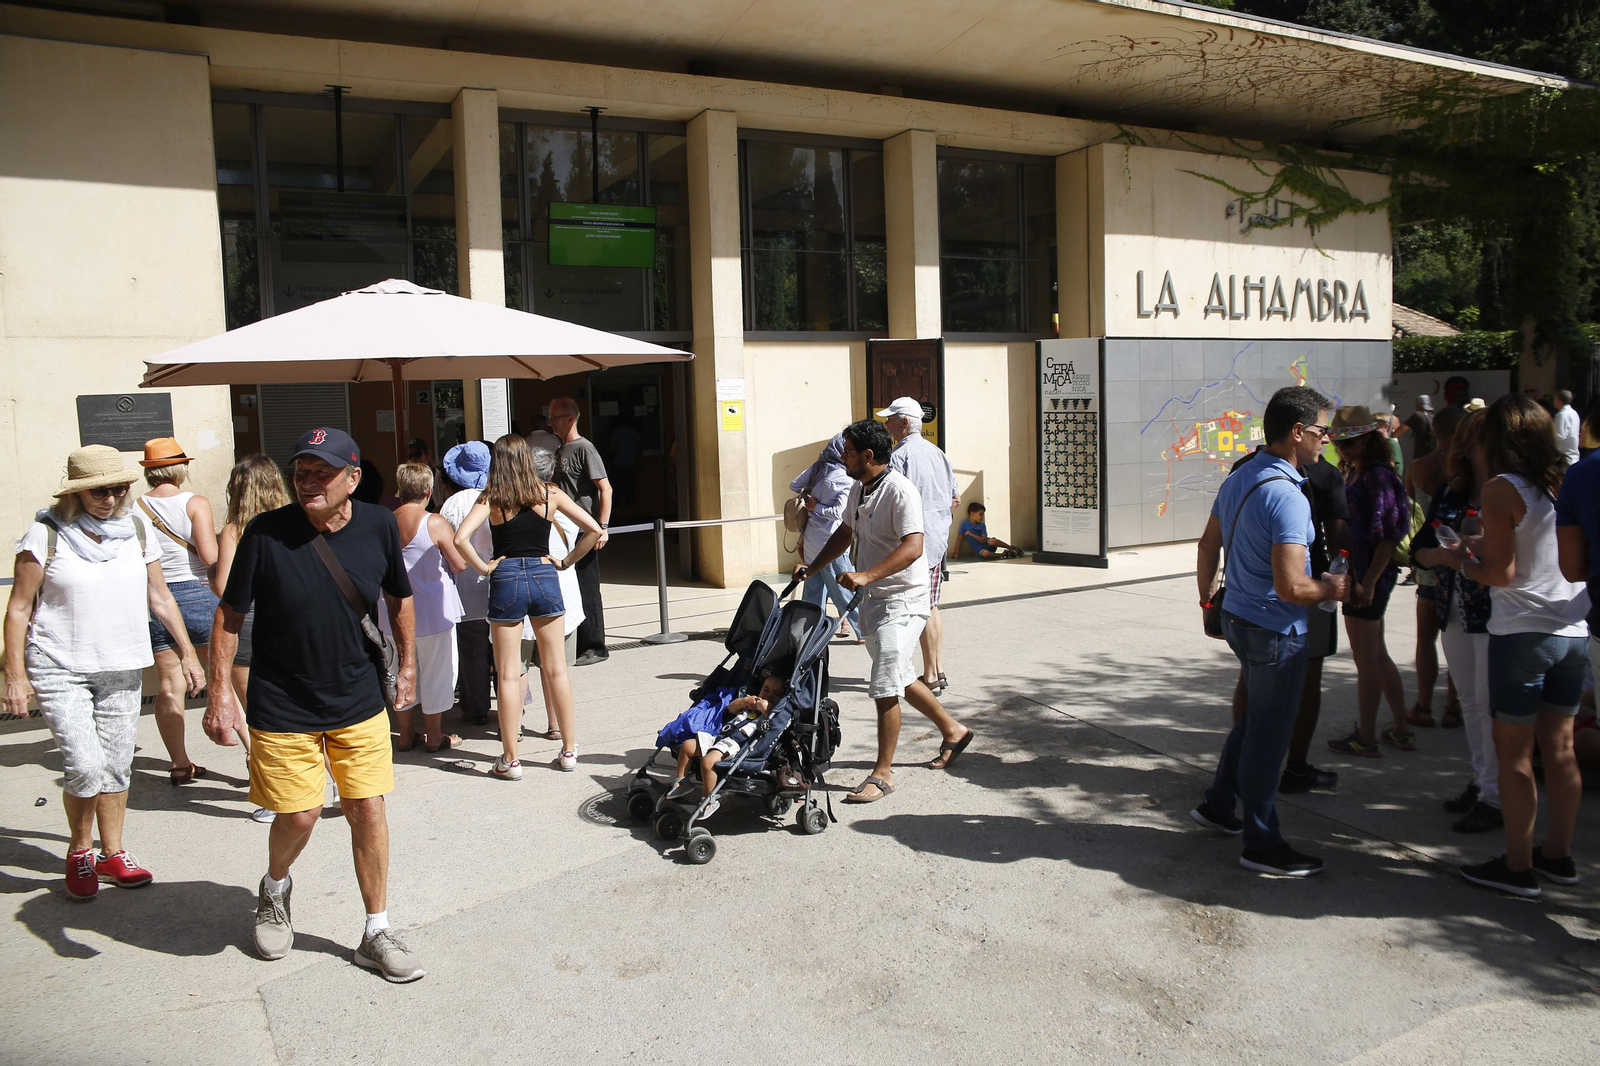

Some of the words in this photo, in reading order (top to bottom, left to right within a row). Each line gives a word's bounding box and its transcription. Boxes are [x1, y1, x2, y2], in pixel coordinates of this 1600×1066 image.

[1136, 269, 1181, 320] LA
[1203, 271, 1371, 324] ALHAMBRA
[419, 391, 429, 404] 2
[308, 429, 328, 445] B
